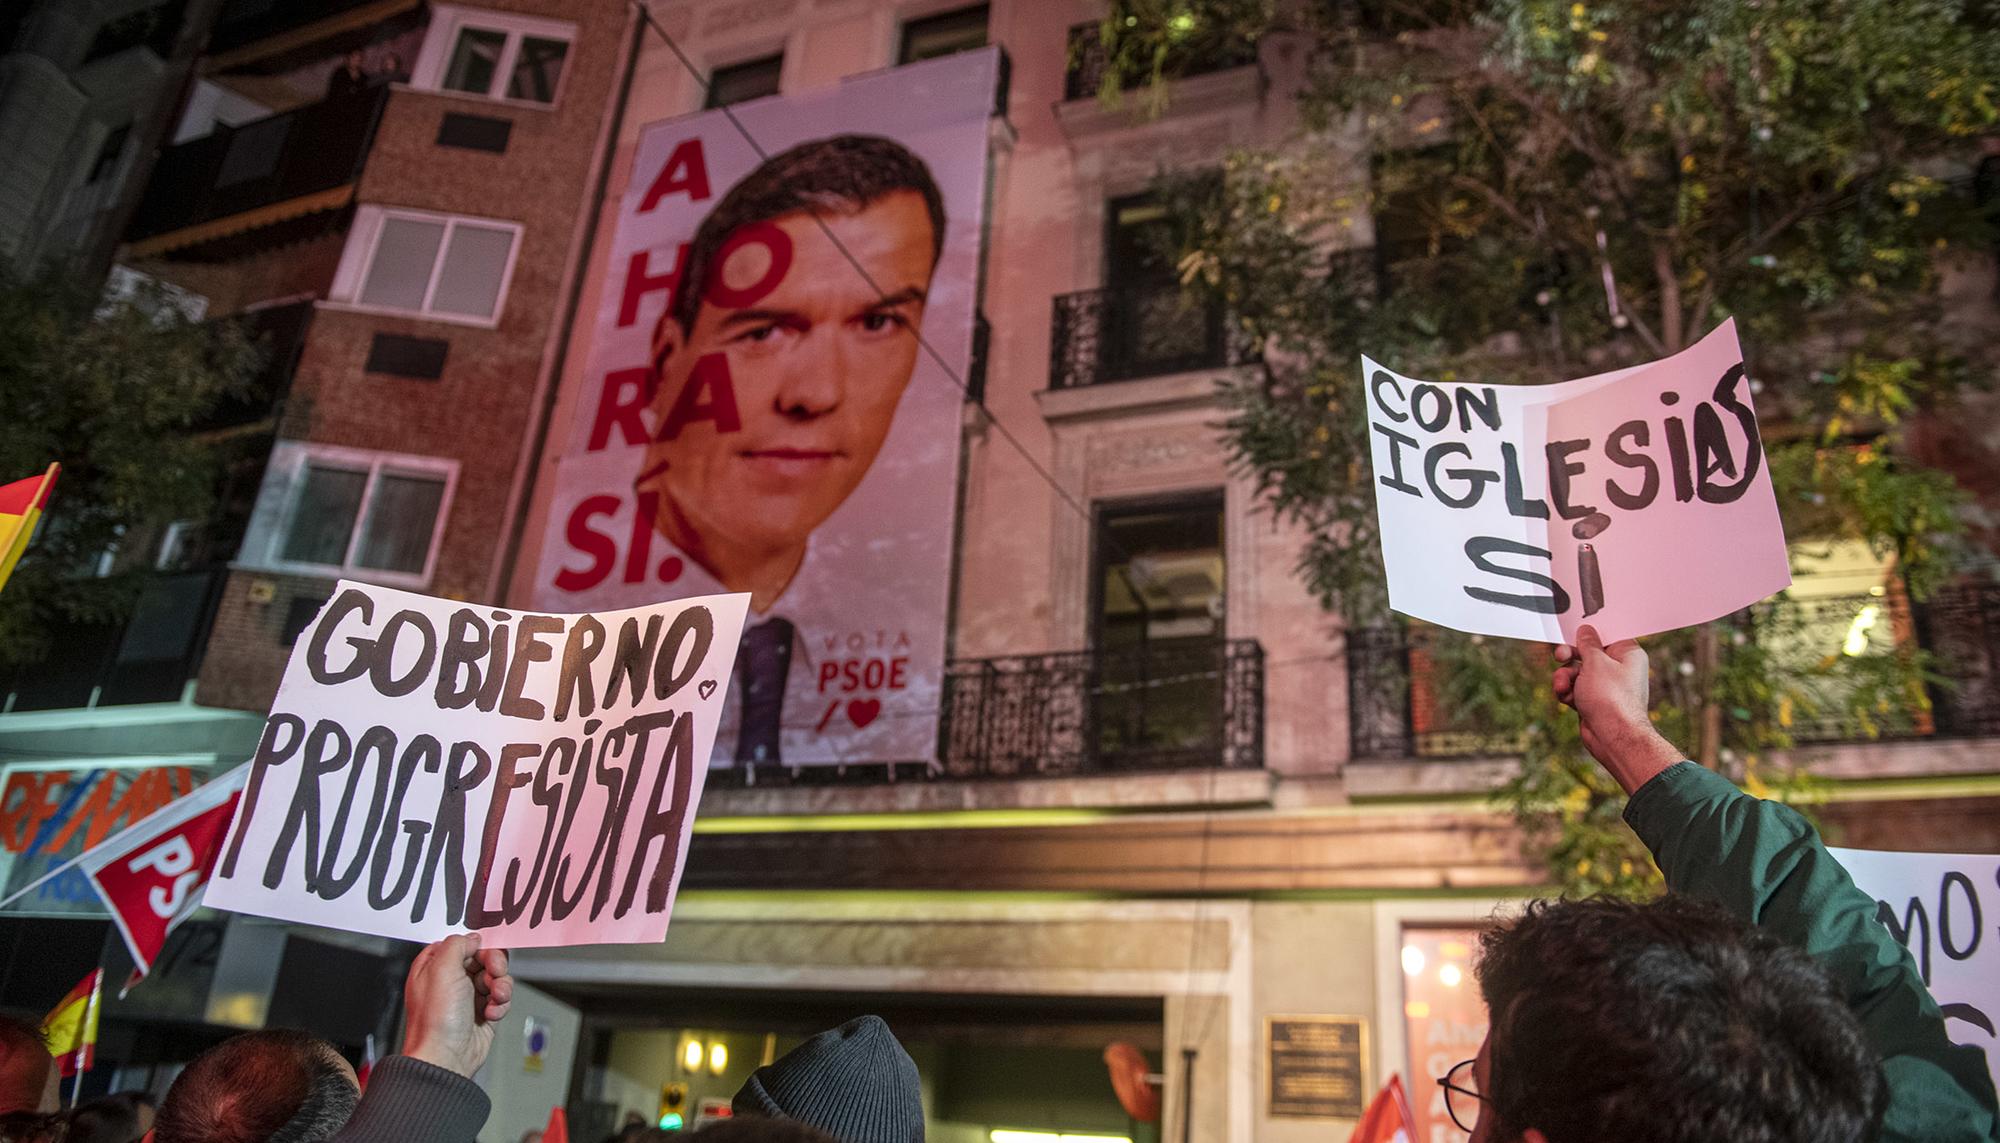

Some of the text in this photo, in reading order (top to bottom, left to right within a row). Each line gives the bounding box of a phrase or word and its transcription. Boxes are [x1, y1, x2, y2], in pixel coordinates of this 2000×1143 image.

[1371, 369, 1502, 433] CON
[823, 629, 911, 651] VOTA
[818, 656, 910, 693] PSOE
